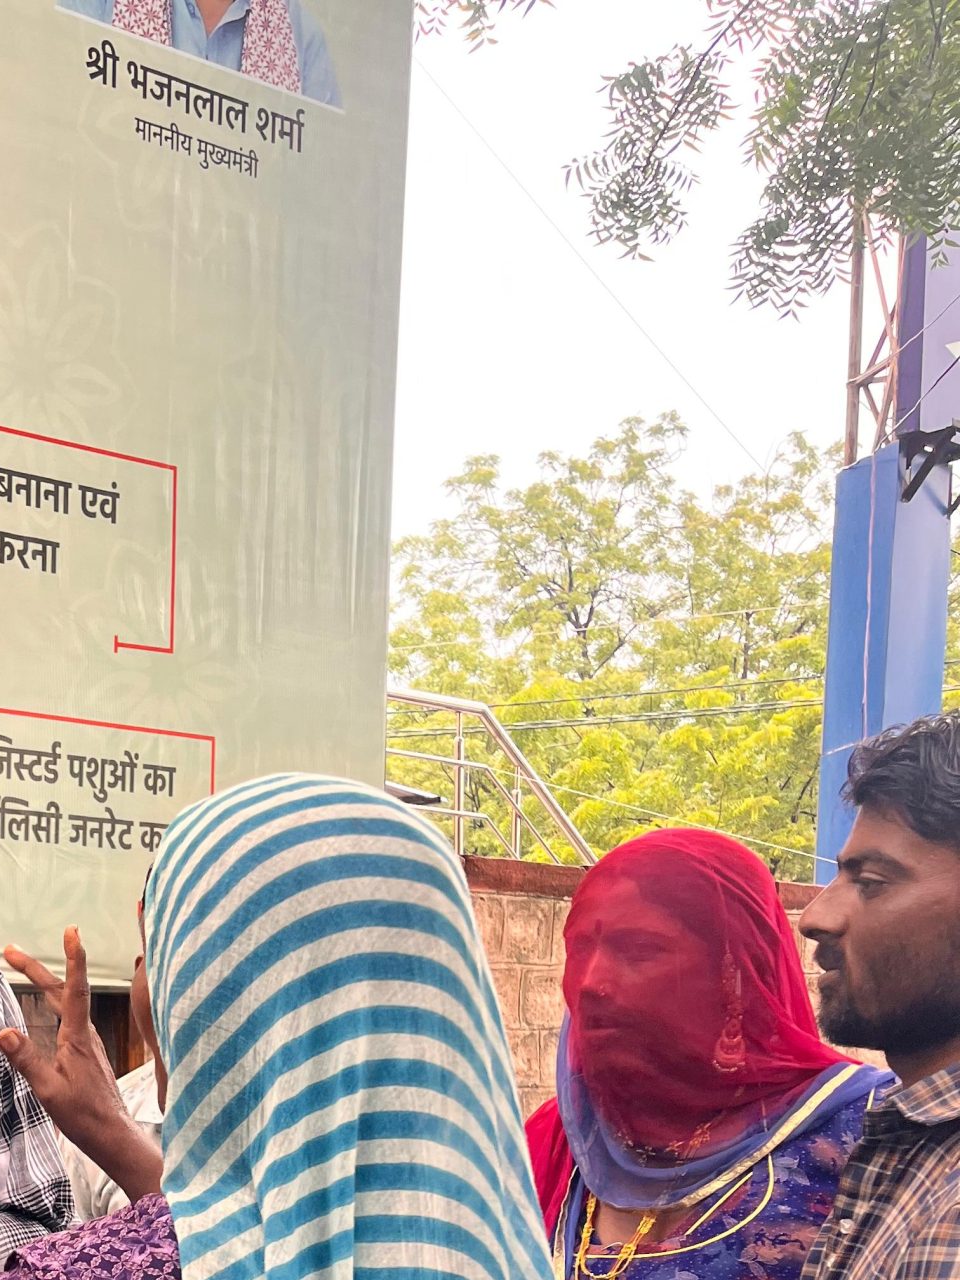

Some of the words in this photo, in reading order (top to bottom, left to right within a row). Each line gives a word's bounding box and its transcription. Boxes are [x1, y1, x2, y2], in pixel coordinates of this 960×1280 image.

[86, 40, 119, 88] श्री
[127, 61, 248, 133] भजनलाल
[256, 108, 305, 153] शर्मा
[134, 117, 192, 155] माननीय
[197, 138, 259, 178] मुख्यमंत्री
[78, 482, 120, 523] एवं
[67, 750, 139, 803] पशुओं
[143, 764, 176, 797] का
[68, 807, 134, 850] जनरेट
